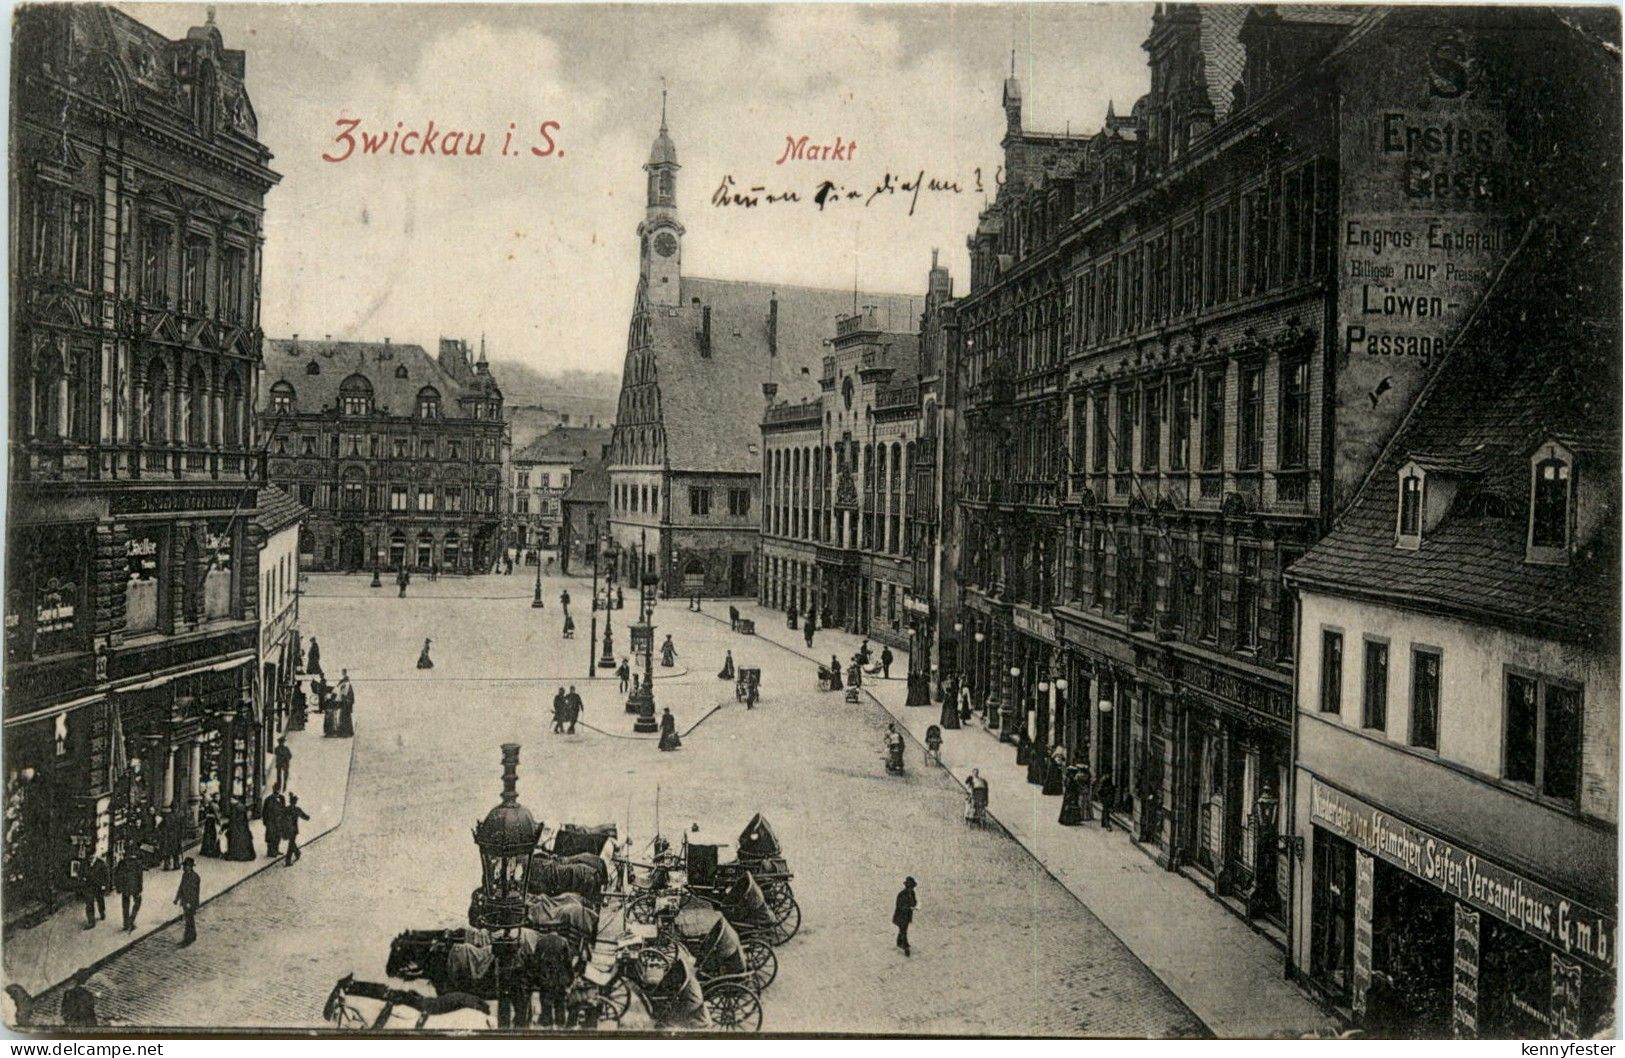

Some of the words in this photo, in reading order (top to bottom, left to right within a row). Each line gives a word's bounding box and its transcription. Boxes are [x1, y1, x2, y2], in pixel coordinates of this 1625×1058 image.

[1383, 112, 1495, 155] Erstes
[1346, 220, 1412, 255] Engros
[1429, 222, 1501, 255] Endetail
[1351, 259, 1395, 281] Billigste
[1404, 263, 1437, 281] nur
[1362, 284, 1460, 319] Löwen-
[1346, 324, 1445, 369] Passage
